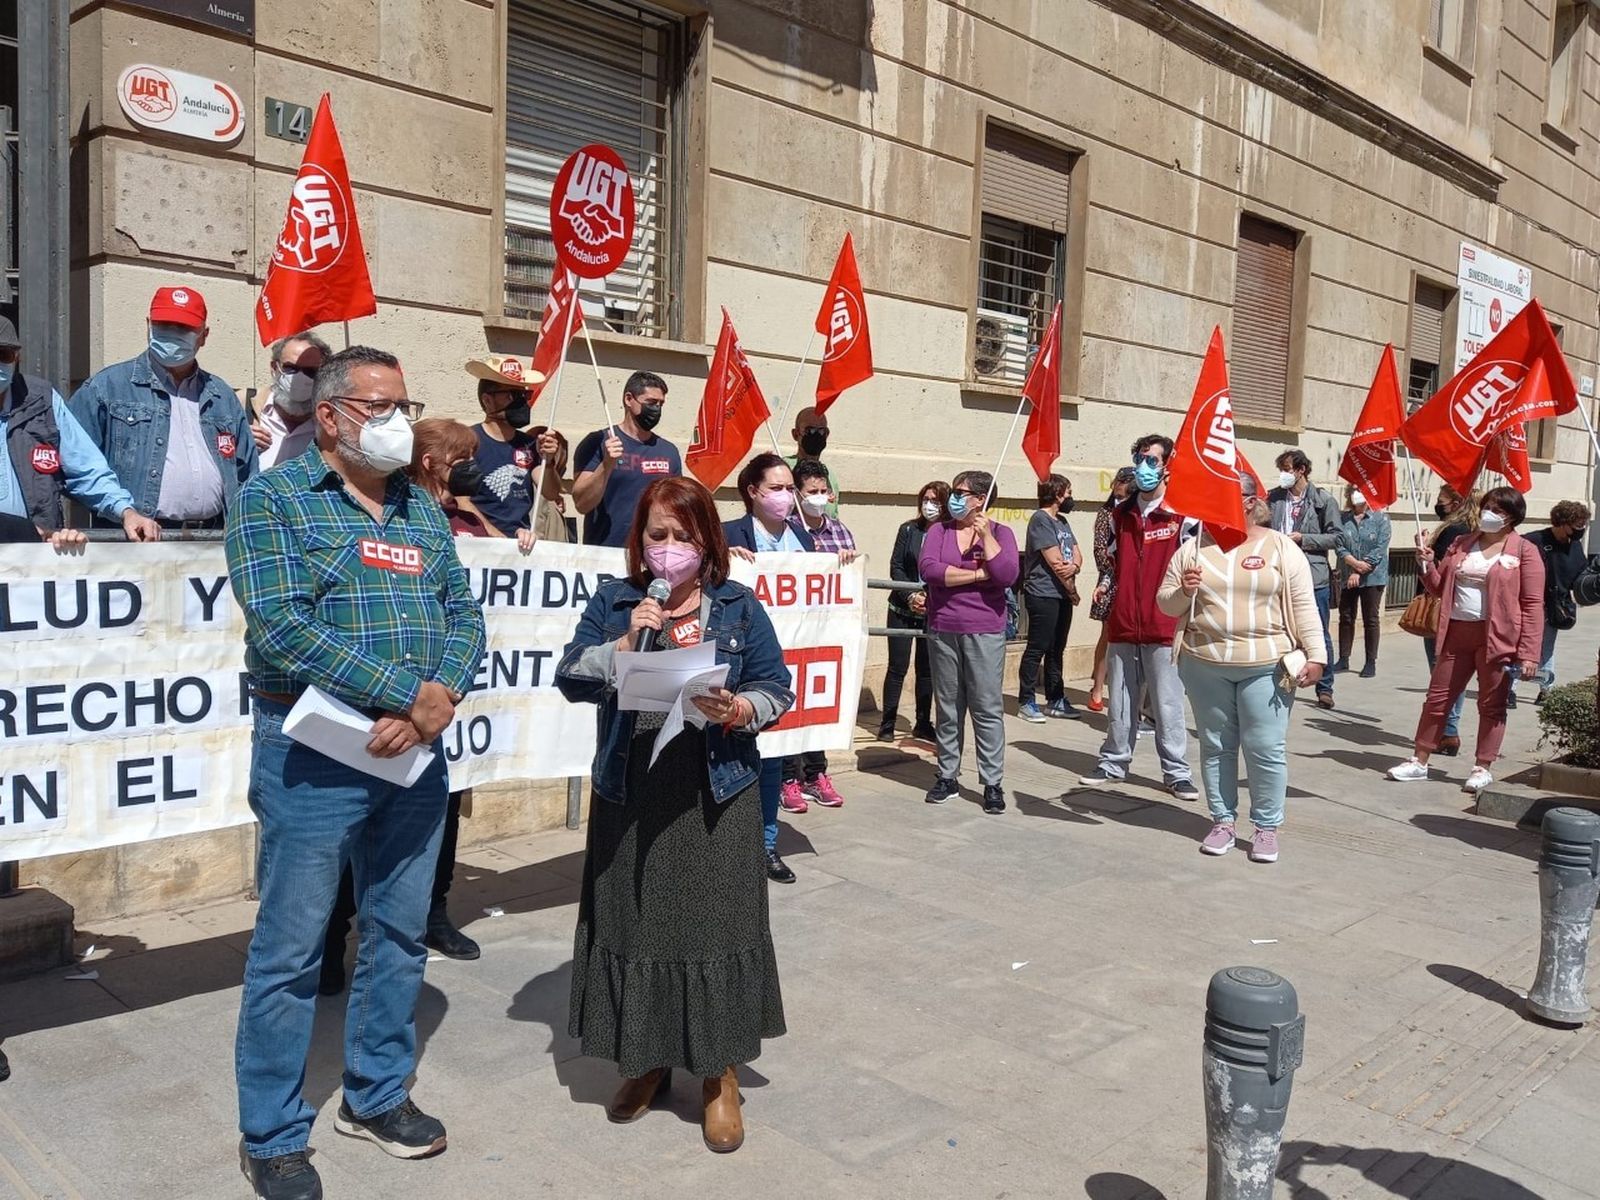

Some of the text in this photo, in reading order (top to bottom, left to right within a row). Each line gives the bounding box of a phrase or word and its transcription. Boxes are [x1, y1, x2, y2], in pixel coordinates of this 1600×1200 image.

[207, 3, 245, 22] Almería
[131, 75, 169, 101] UGT
[274, 101, 307, 140] 14
[566, 151, 628, 218] UGT
[293, 175, 341, 251] UGT
[1491, 310, 1500, 322] NO
[1454, 365, 1517, 428] UGT
[32, 448, 57, 464] UGT
[1144, 528, 1170, 541] CCOO
[362, 541, 419, 566] CCOO
[188, 576, 229, 621] Y
[754, 573, 853, 606] ABRIL
[117, 755, 197, 807] EL
